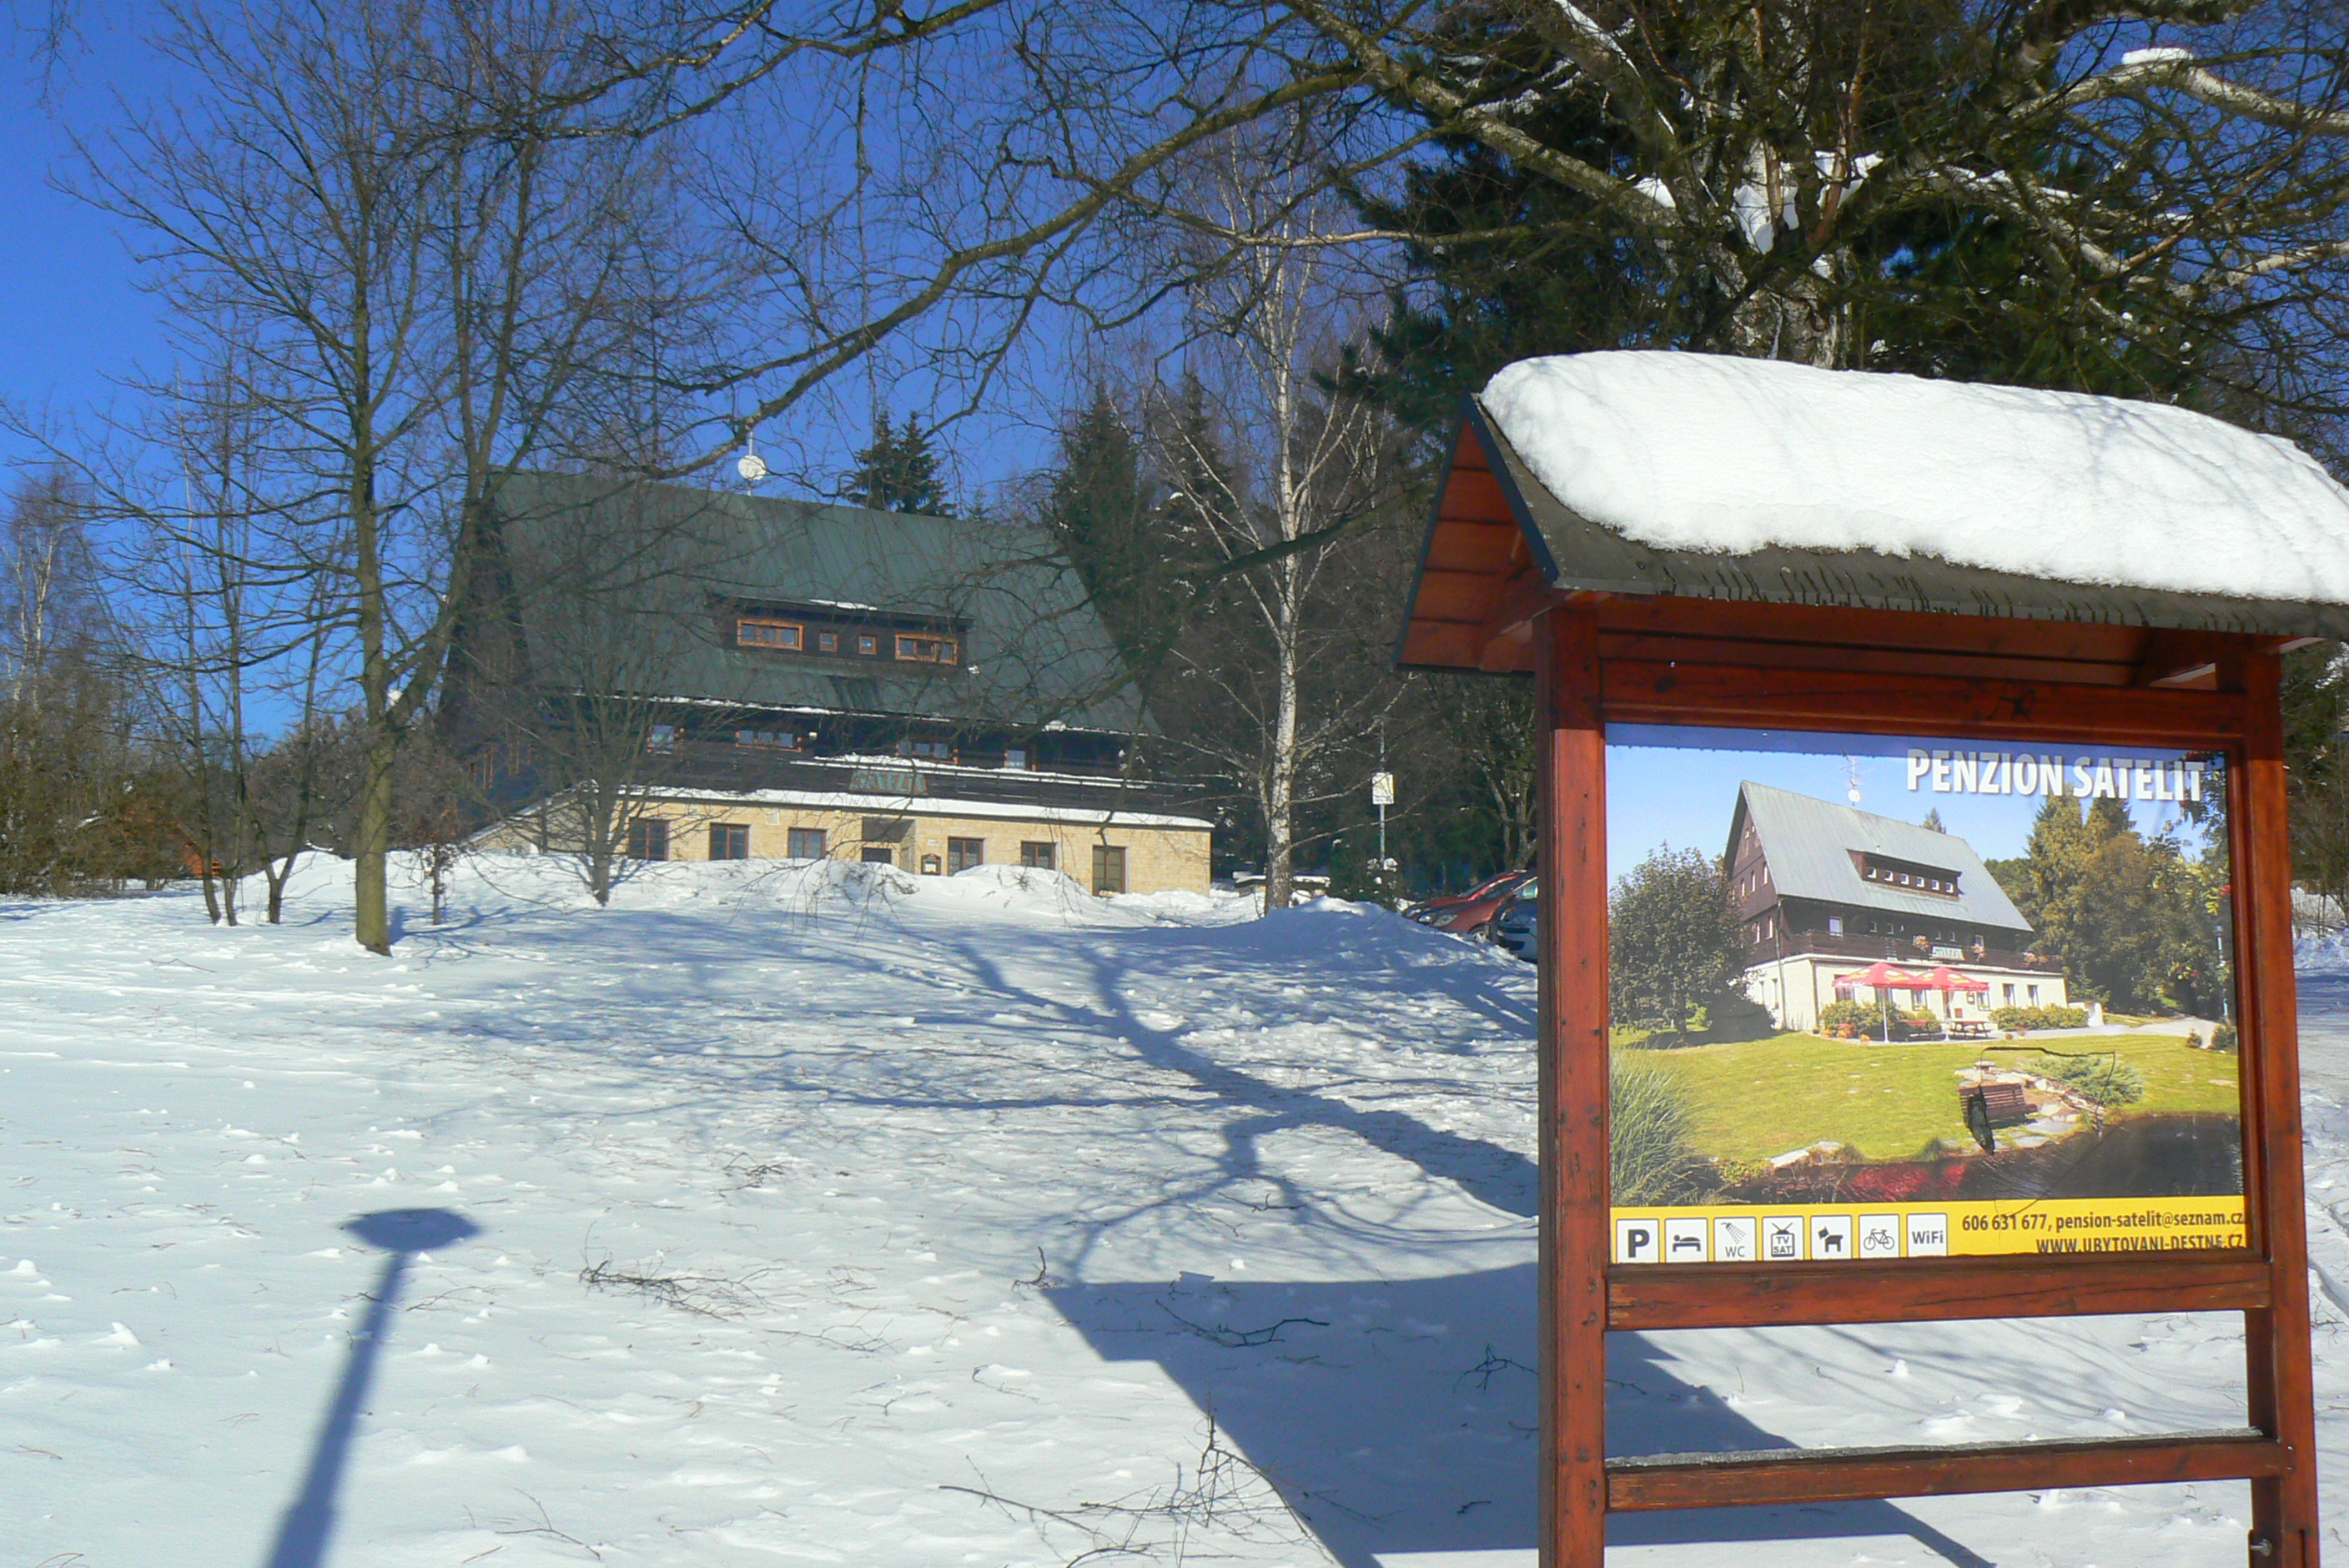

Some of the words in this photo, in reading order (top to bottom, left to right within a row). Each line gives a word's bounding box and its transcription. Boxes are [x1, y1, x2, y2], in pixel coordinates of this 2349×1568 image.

[1907, 749, 2063, 796] PENZION
[2073, 756, 2206, 802] SATELIT
[1962, 1214, 1989, 1231] 606
[1992, 1214, 2018, 1230] 631
[2021, 1214, 2053, 1233] 677,
[2055, 1210, 2246, 1233] pension-satelit@seznam.cz
[1627, 1229, 1650, 1258] P
[1776, 1236, 1789, 1244] TV
[1911, 1230, 1944, 1244] WiFi
[1724, 1246, 1745, 1258] WC
